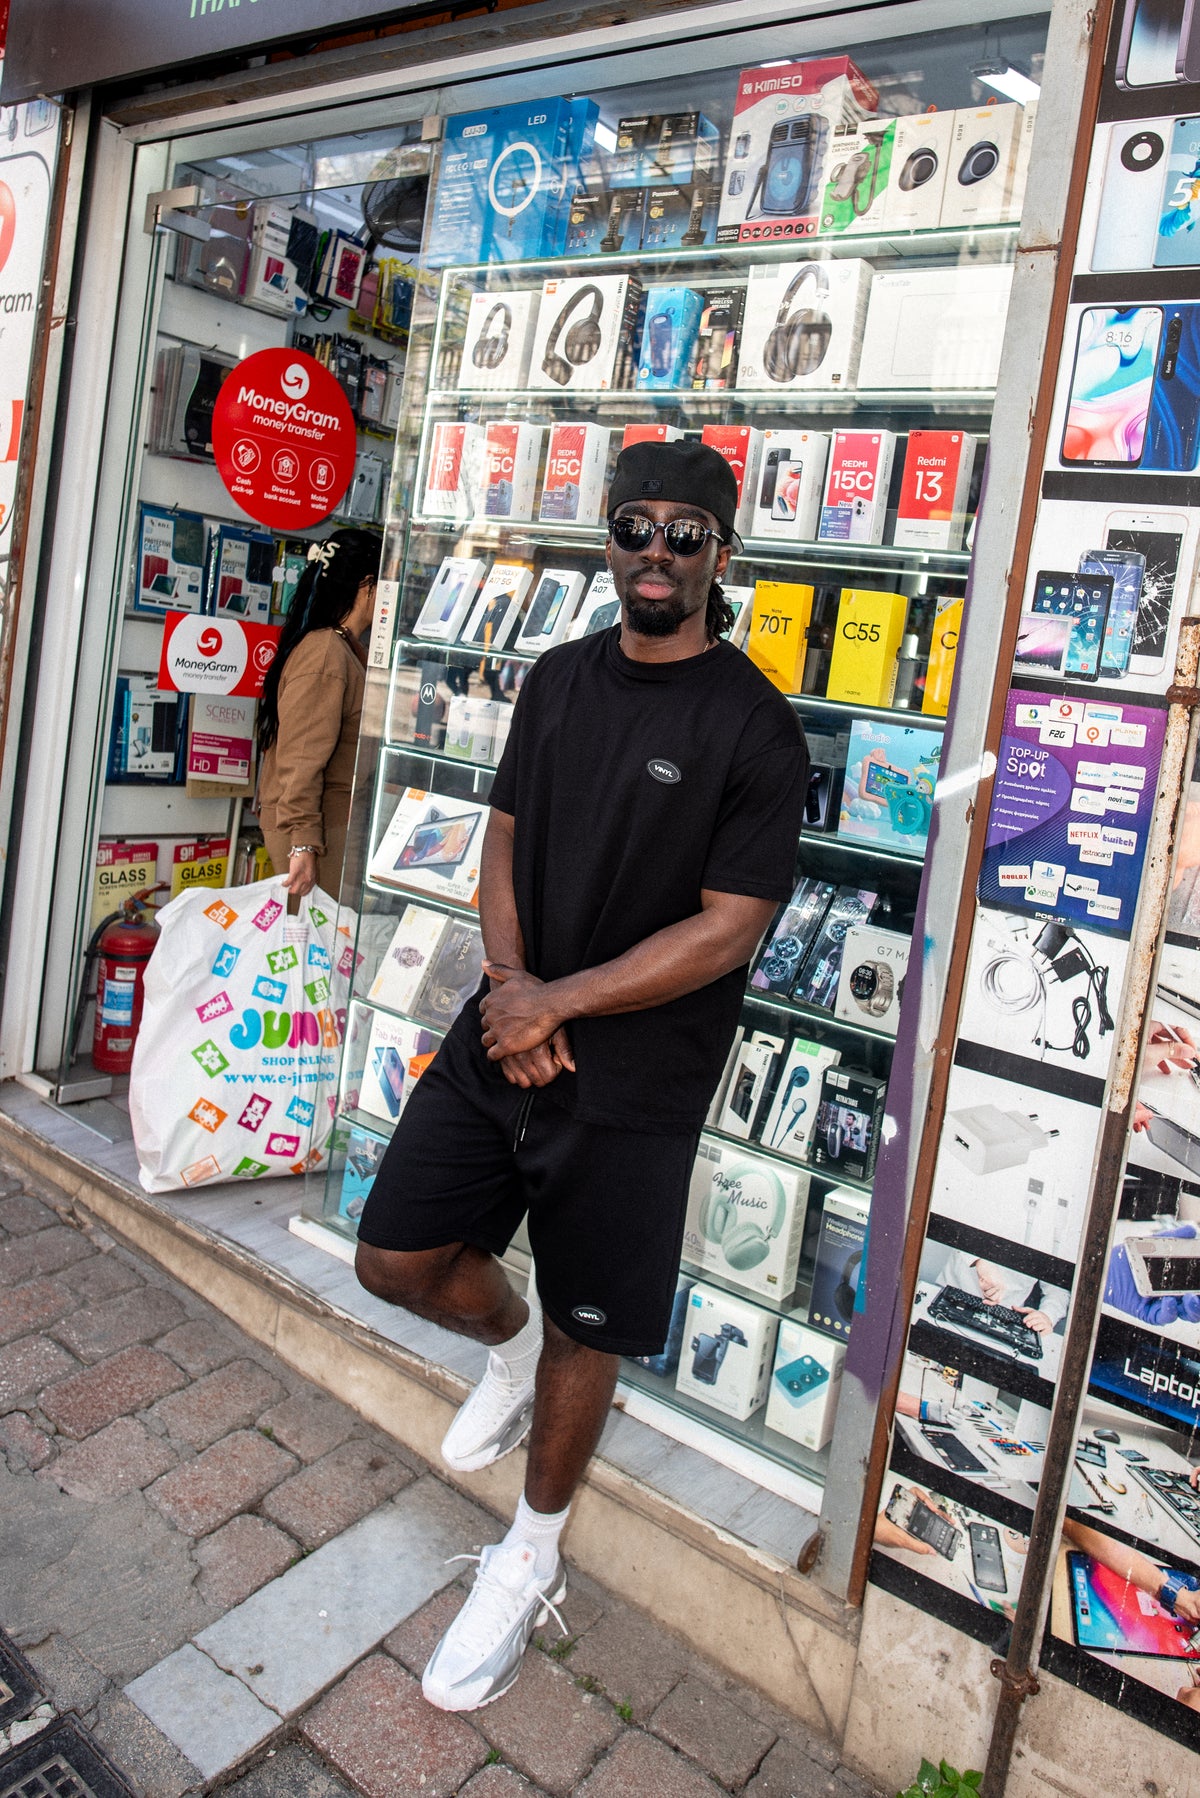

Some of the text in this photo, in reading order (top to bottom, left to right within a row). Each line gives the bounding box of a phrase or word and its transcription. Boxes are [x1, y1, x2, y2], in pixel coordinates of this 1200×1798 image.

[754, 74, 802, 93] KIMISO
[528, 114, 547, 126] LED
[1105, 331, 1133, 344] 8:16
[237, 386, 340, 431] MoneyGram
[253, 414, 326, 441] money transfer
[557, 449, 577, 457] REDMI
[551, 459, 580, 476] 15C
[842, 459, 868, 468] REDMI
[917, 456, 947, 467] Redmi
[235, 476, 252, 486] Cash
[832, 470, 874, 490] 15C
[915, 471, 943, 502] 13
[231, 484, 255, 496] pick-up
[271, 485, 296, 496] Direct to
[263, 492, 278, 502] bank
[144, 543, 160, 553] CASE
[221, 565, 236, 574] CASE
[492, 568, 520, 578] Galaxy
[591, 586, 608, 594] A07
[759, 614, 792, 635] 70T
[842, 622, 881, 642] C55
[175, 657, 237, 673] MoneyGram
[183, 672, 227, 682] money transfer
[206, 704, 246, 721] SCREEN
[1010, 746, 1049, 761] TOP-UP
[193, 758, 211, 772] HD
[654, 764, 673, 777] VINYL
[1069, 831, 1099, 839] NETFLIX
[1102, 834, 1134, 847] twitch
[96, 848, 112, 865] 9H
[180, 846, 194, 861] 9H
[99, 868, 146, 885] GLASS
[181, 863, 222, 880] GLASS
[1037, 889, 1056, 899] XBOX
[877, 945, 893, 957] G7
[262, 1056, 295, 1066] SHOP
[712, 1171, 743, 1191] Free
[727, 1190, 768, 1210] Music
[578, 1311, 600, 1321] VINYL
